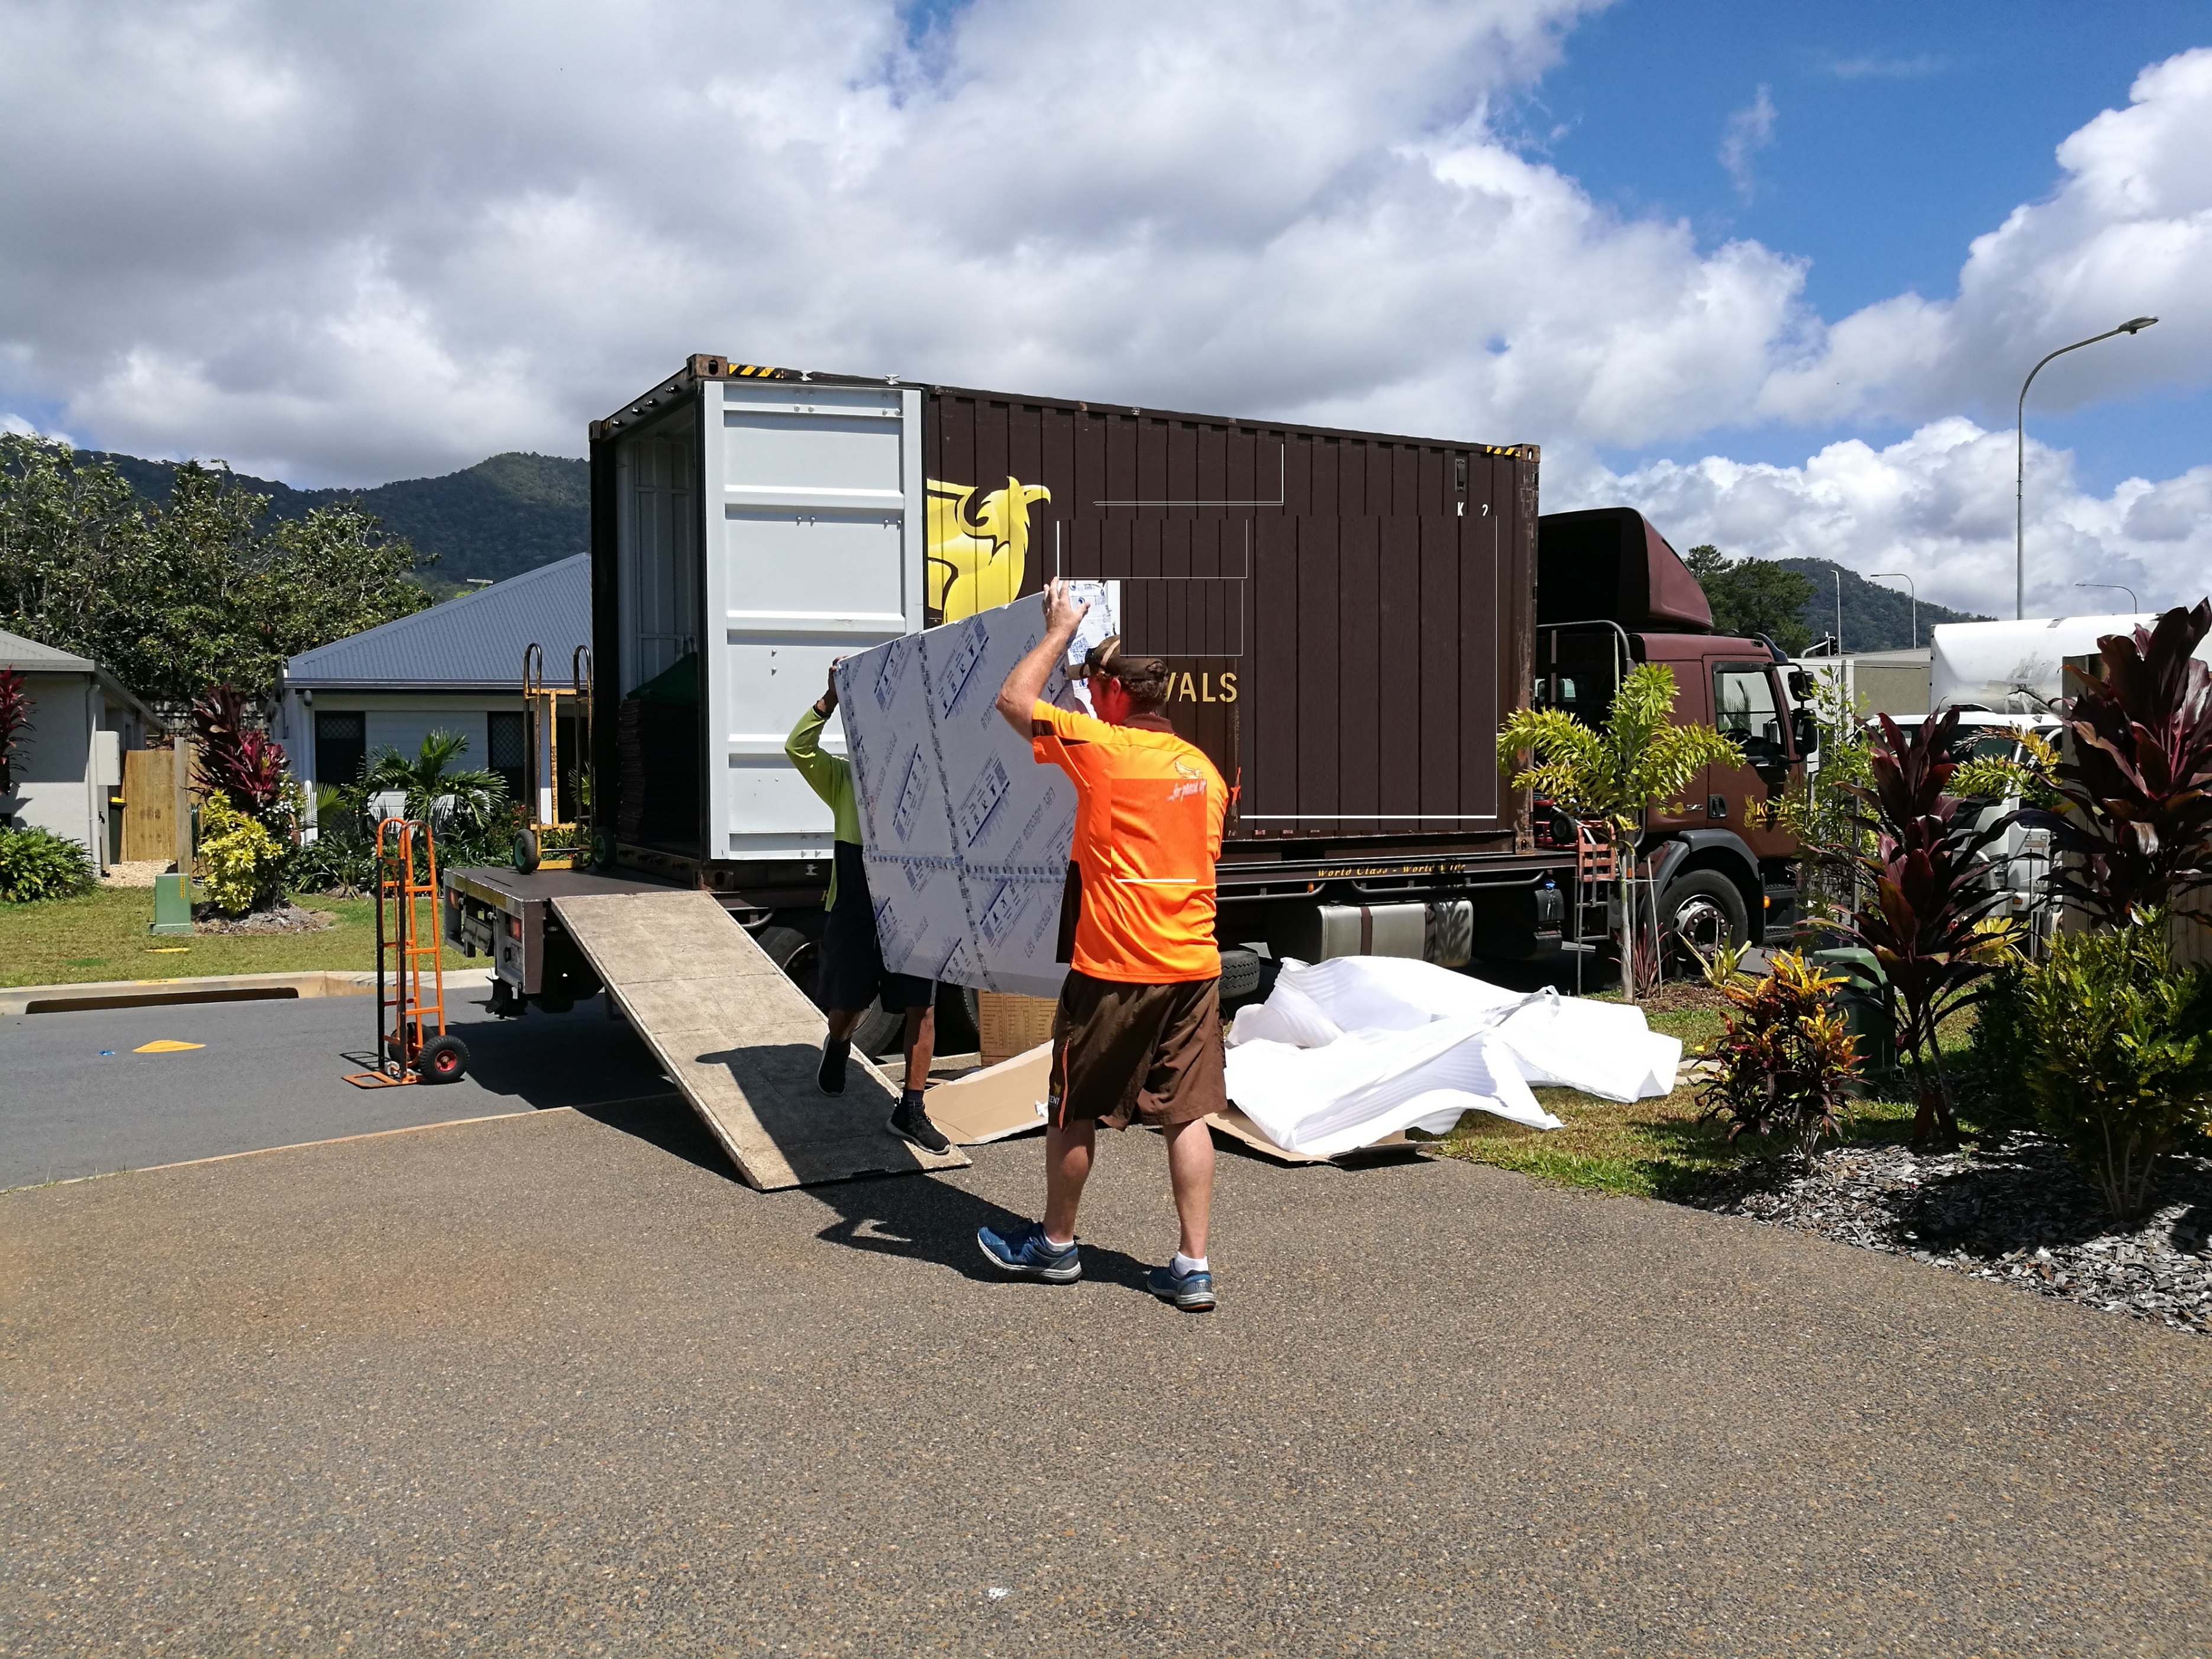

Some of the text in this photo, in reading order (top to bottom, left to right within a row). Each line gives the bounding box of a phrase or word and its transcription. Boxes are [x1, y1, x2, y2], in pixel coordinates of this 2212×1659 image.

[1317, 866, 1352, 877] World
[1356, 866, 1388, 876] Class
[1403, 863, 1436, 873] World
